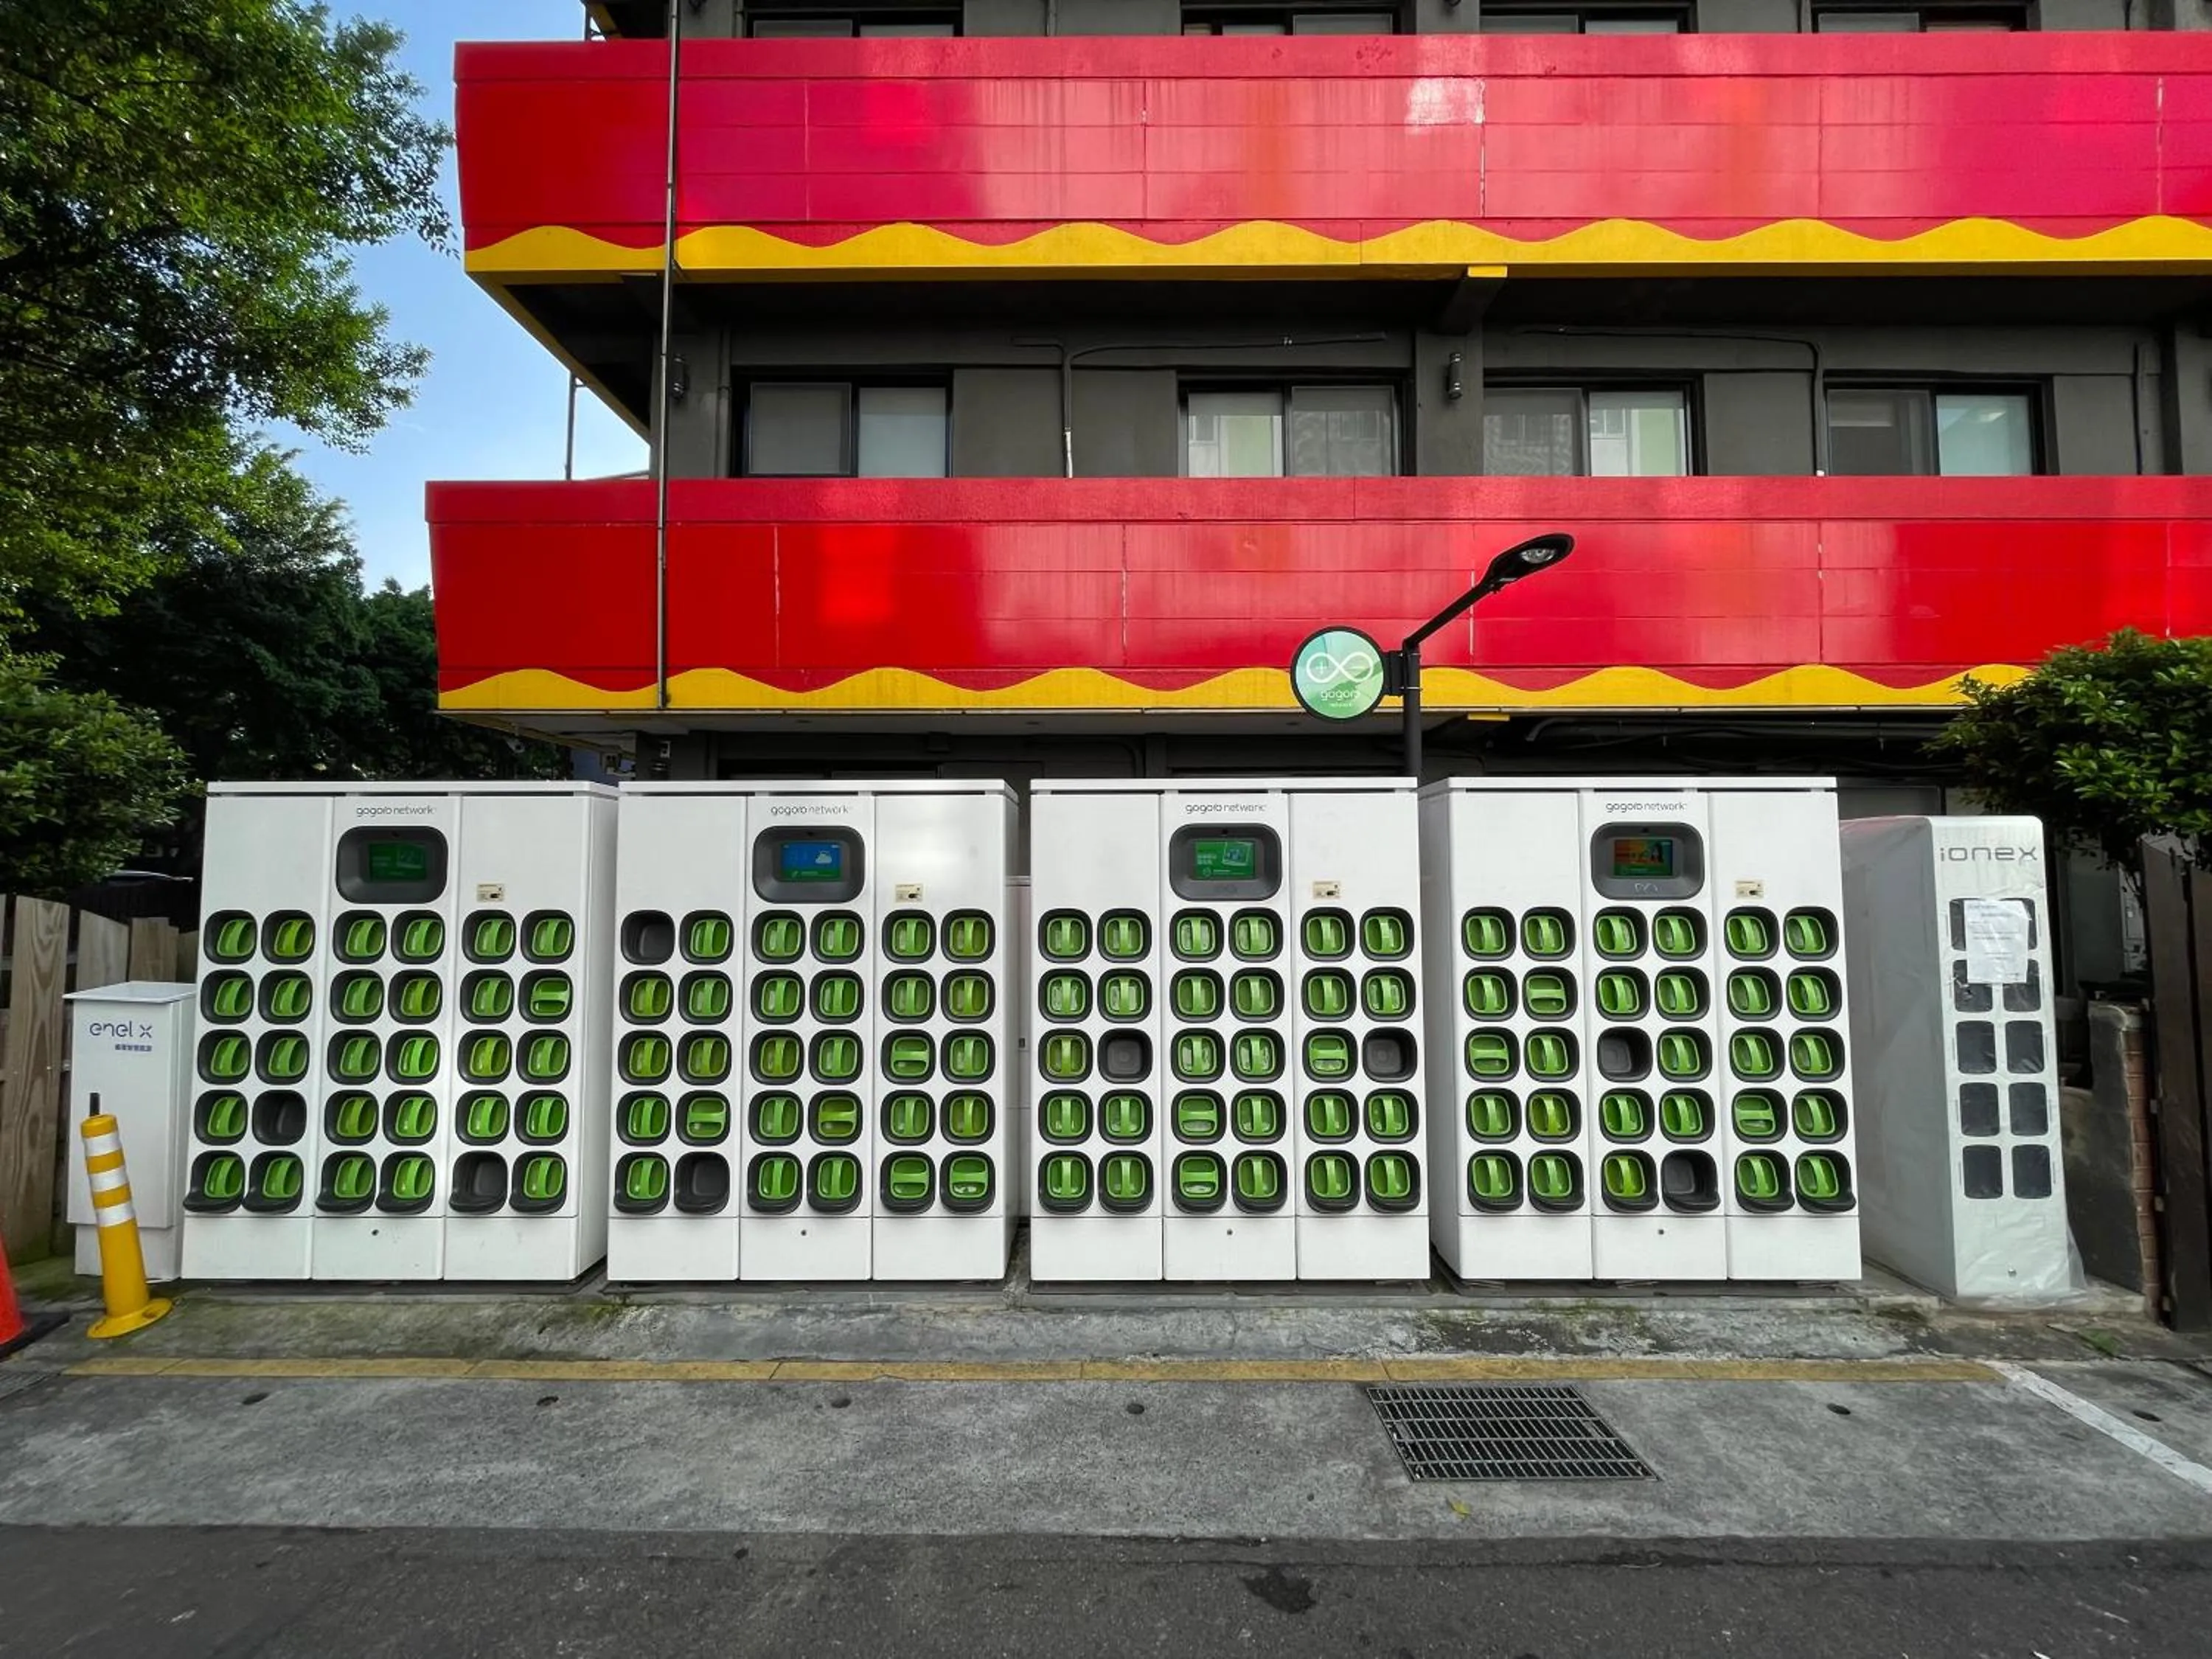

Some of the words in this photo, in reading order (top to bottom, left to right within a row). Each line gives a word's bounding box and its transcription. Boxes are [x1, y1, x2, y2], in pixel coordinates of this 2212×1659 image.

[356, 806, 392, 818] gogoro
[393, 804, 434, 815] network
[771, 806, 807, 816] gogoro
[809, 804, 849, 815] network
[1186, 804, 1222, 815] gogoro
[1606, 802, 1643, 813] gogoro
[1644, 801, 1684, 811] network
[1940, 846, 2037, 863] ionex
[89, 1020, 133, 1037] enel
